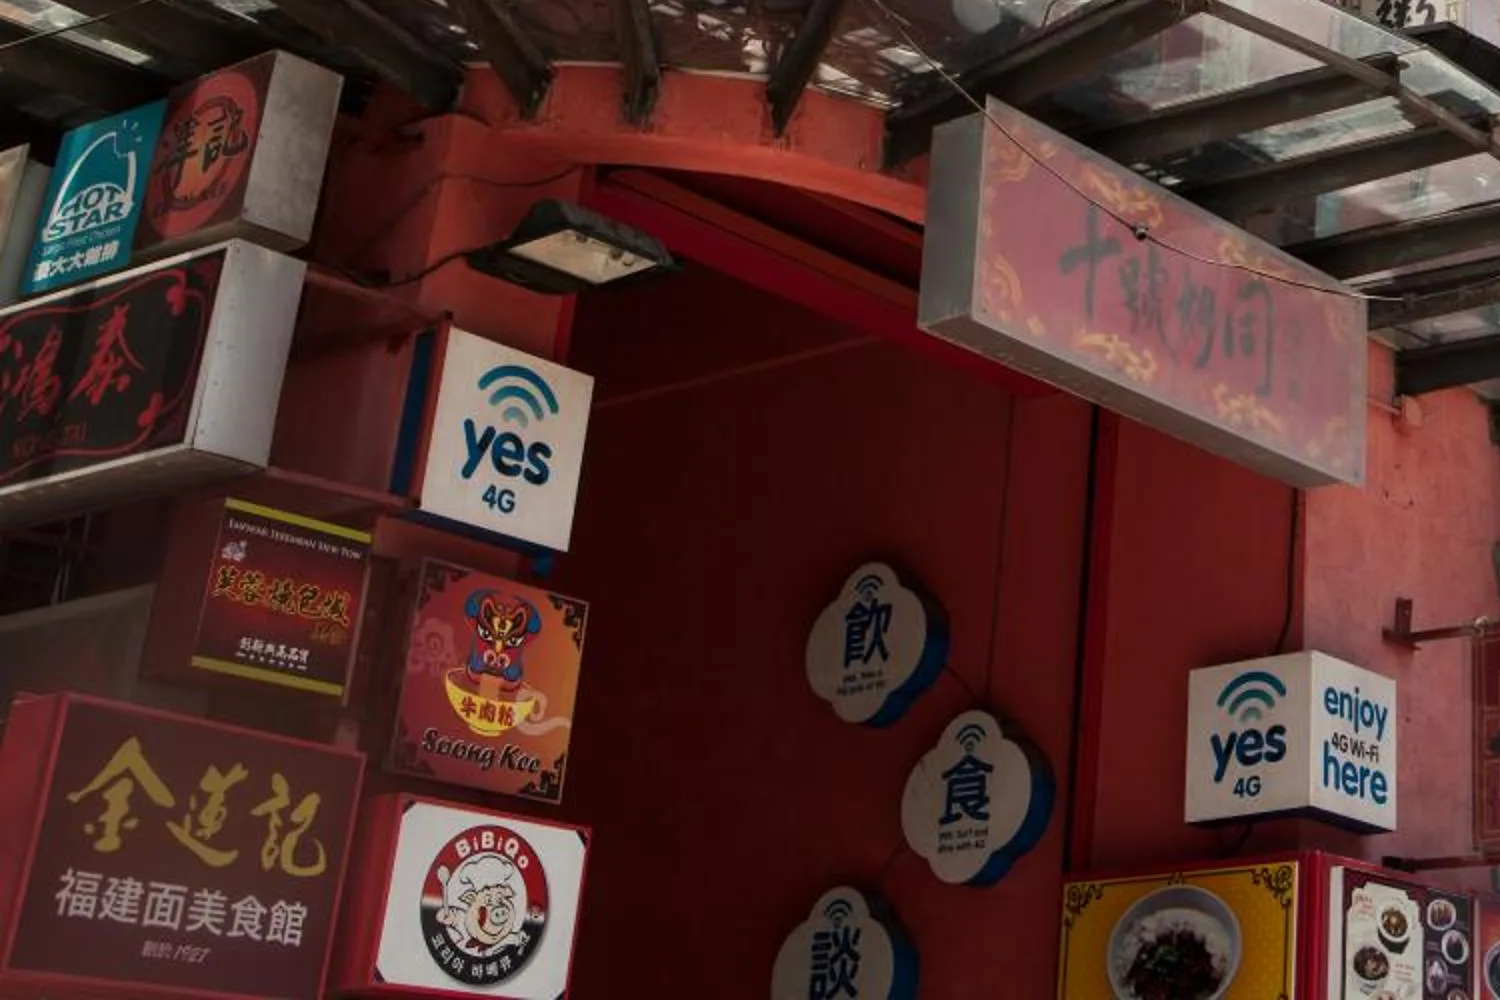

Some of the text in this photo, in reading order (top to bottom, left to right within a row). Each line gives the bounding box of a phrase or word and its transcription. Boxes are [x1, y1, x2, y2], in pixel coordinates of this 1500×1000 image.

[45, 201, 125, 241] STAR
[460, 418, 552, 486] yes
[481, 484, 516, 513] 4G
[459, 695, 515, 727] 牛肉粉
[1323, 686, 1388, 741] enjoy
[500, 740, 543, 775] Kee
[1210, 723, 1287, 783] yes
[1330, 731, 1380, 764] 4G Wi-Fi
[938, 753, 994, 825] 食
[1233, 776, 1262, 798] 4G
[1323, 740, 1388, 805] here
[455, 830, 530, 870] BiBiQo
[53, 866, 309, 949] 福建面美食館
